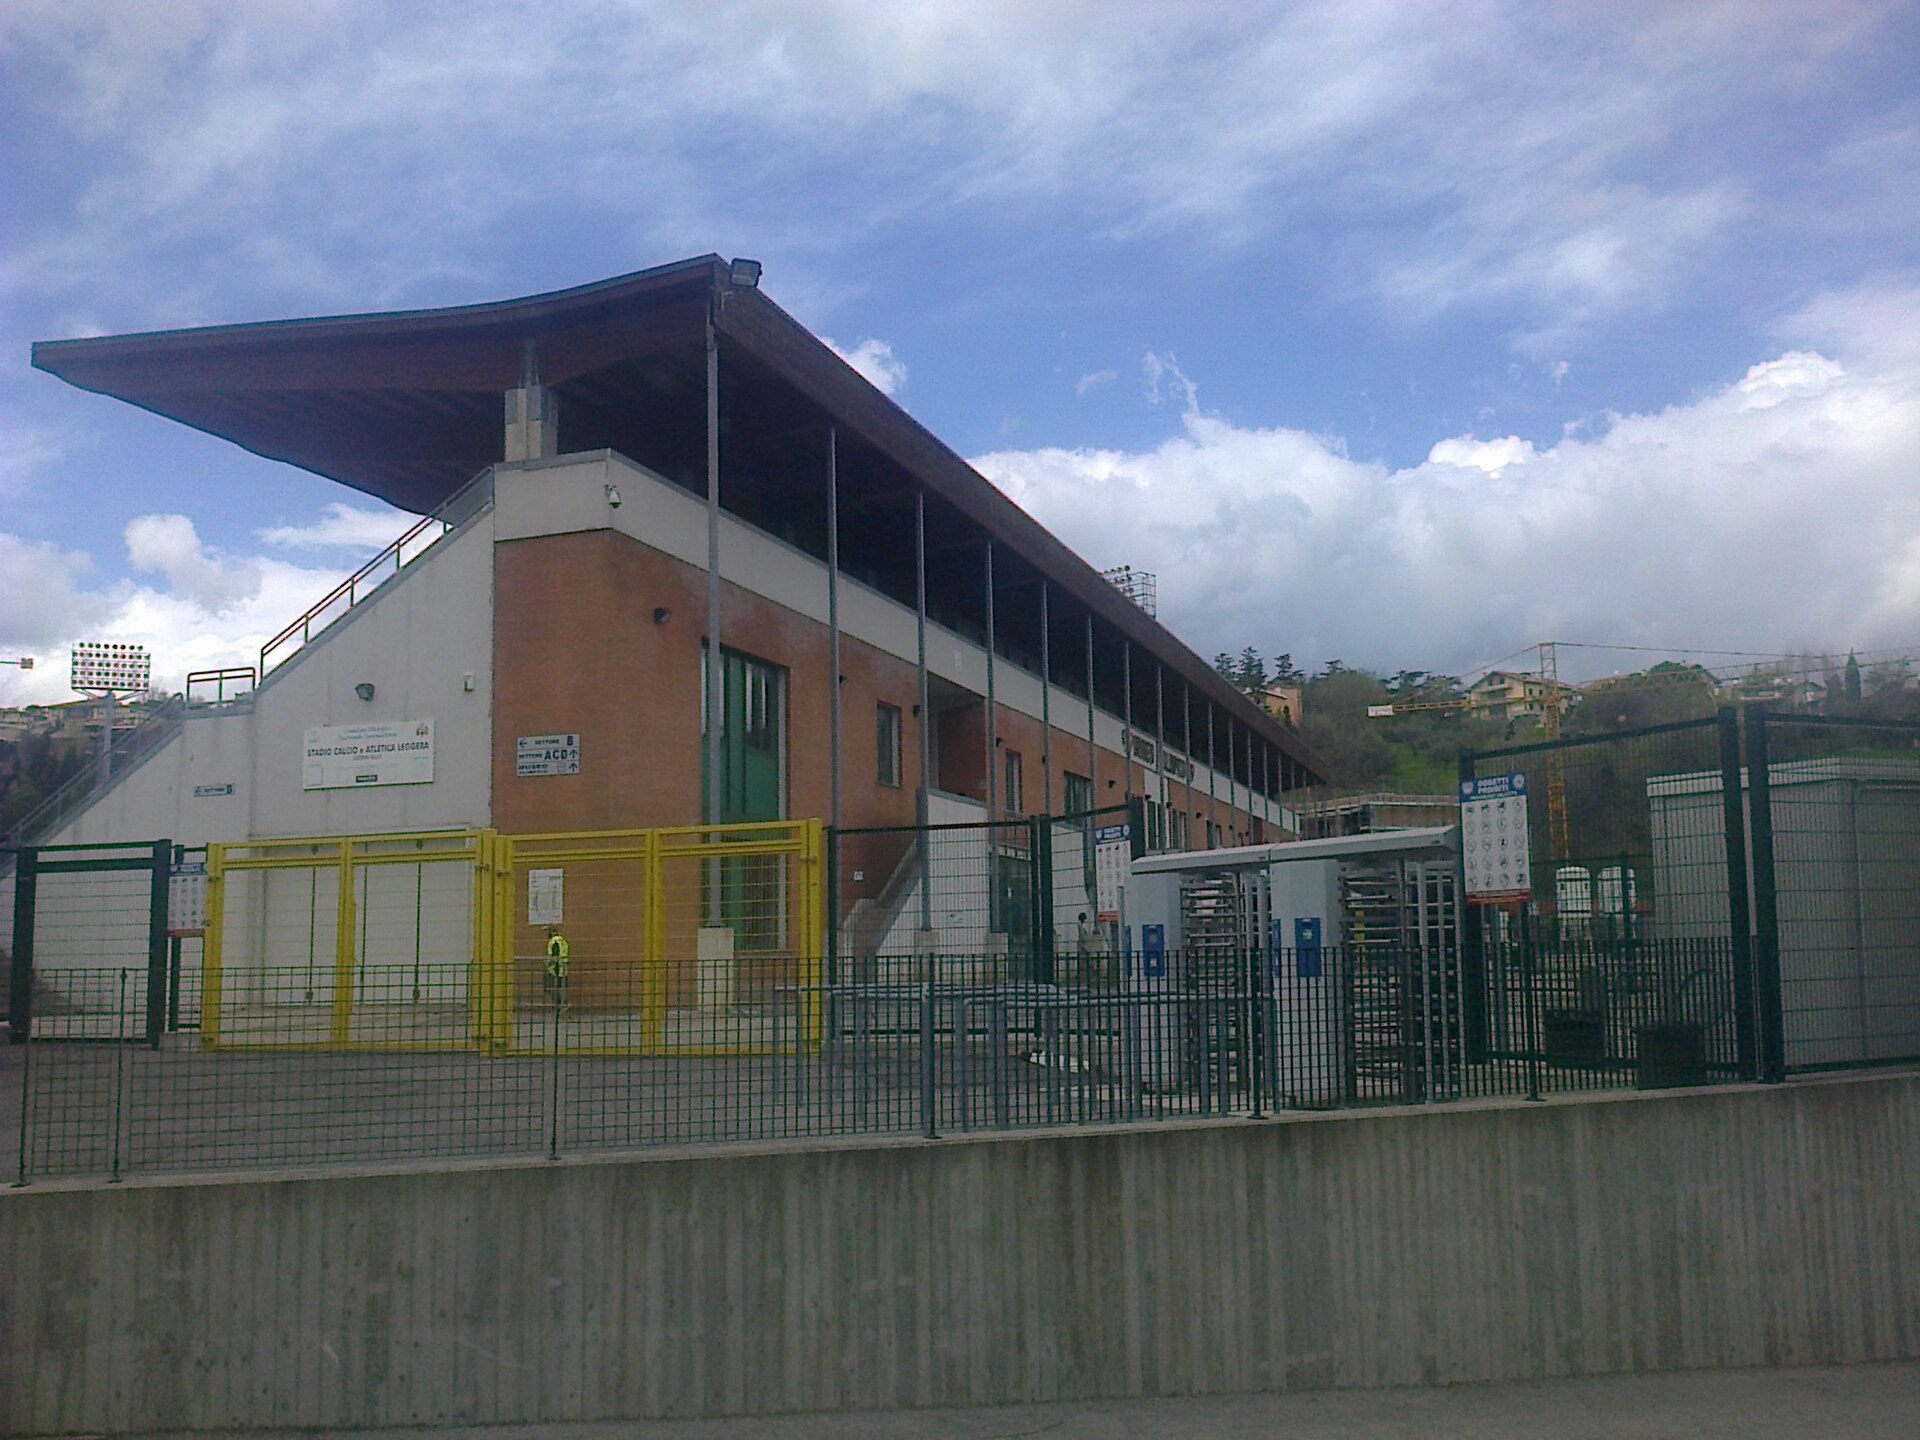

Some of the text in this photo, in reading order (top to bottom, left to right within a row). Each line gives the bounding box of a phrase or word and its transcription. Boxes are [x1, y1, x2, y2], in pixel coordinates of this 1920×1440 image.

[567, 735, 574, 746] B
[307, 748, 331, 757] STADIO
[334, 746, 358, 756] CALCIO
[365, 743, 396, 754] ATLETICA
[398, 741, 429, 752] LEGGERA
